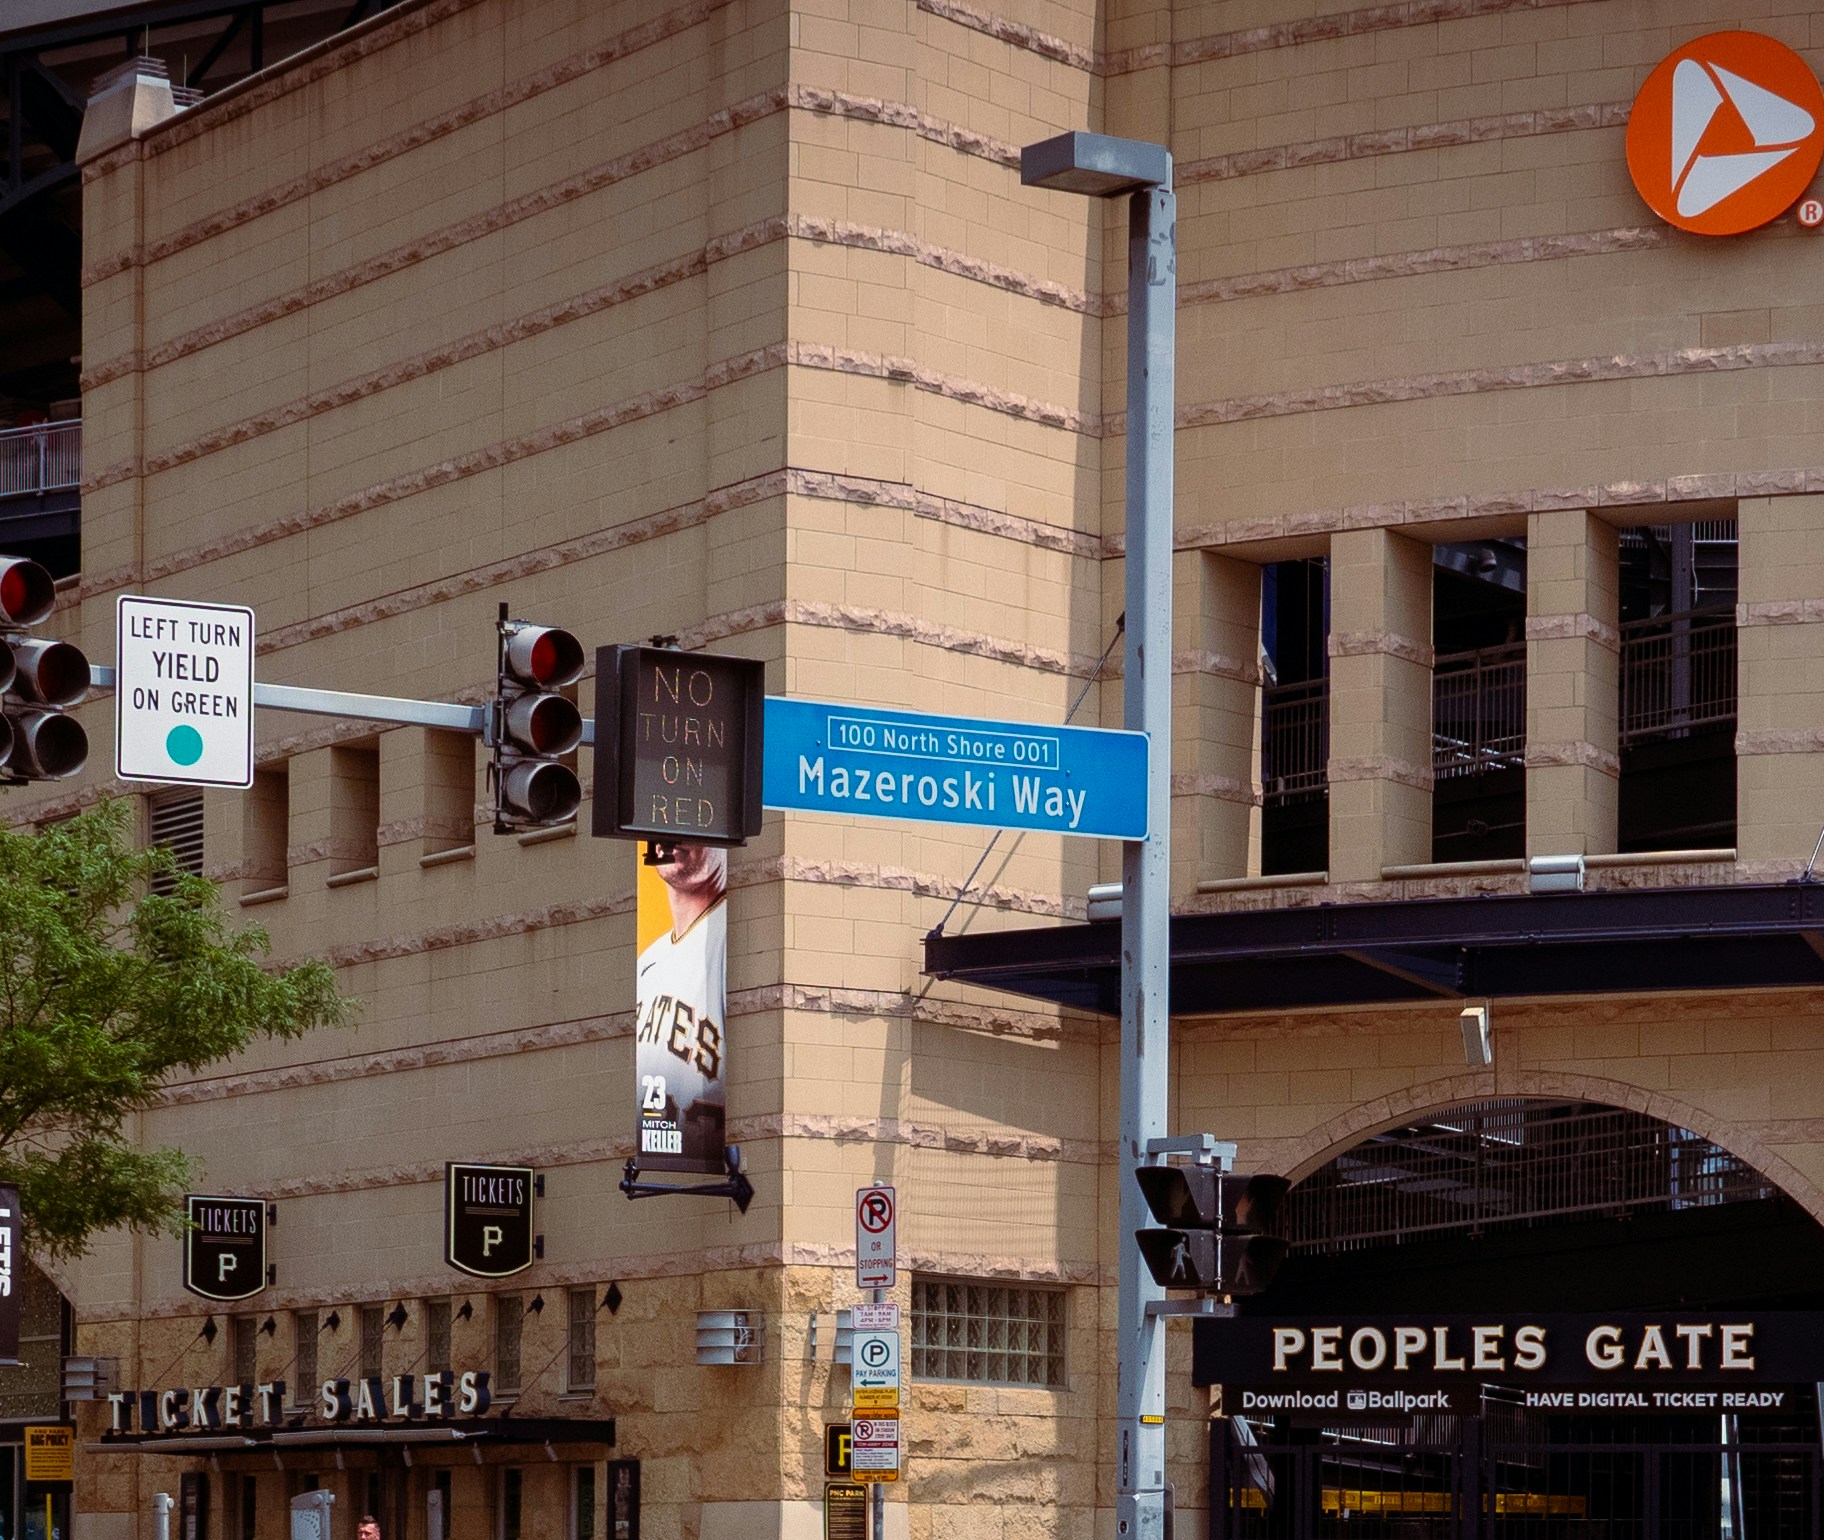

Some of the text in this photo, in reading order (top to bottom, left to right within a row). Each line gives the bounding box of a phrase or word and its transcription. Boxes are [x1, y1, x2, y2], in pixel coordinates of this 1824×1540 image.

[131, 615, 240, 648] LEFT TURN
[152, 650, 220, 683] YIELD
[654, 666, 713, 707] NO
[133, 687, 238, 718] ON GREEN
[639, 712, 725, 749] TURN
[839, 723, 1050, 763] 100 North Shore 001
[662, 756, 703, 787] ON
[798, 754, 1087, 829] Mazeroski Way
[651, 794, 715, 828] RED
[641, 1074, 667, 1110] 23
[642, 1120, 676, 1130] MITCH
[641, 1128, 683, 1154] KELLER
[462, 1176, 523, 1205] TICKETS
[199, 1207, 256, 1234] TICKETS
[482, 1225, 503, 1257] P
[871, 1241, 881, 1252] OR
[218, 1253, 237, 1281] P
[860, 1258, 893, 1270] STOPPING
[1272, 1323, 1755, 1372] PEOPLES GATE
[868, 1369, 896, 1377] PARKING
[322, 1371, 484, 1420] SALES
[1242, 1390, 1450, 1412] Download Ballpark
[1526, 1392, 1784, 1407] HAVE DIGITAL TICKET READY
[829, 1489, 865, 1497] PNC PARK
